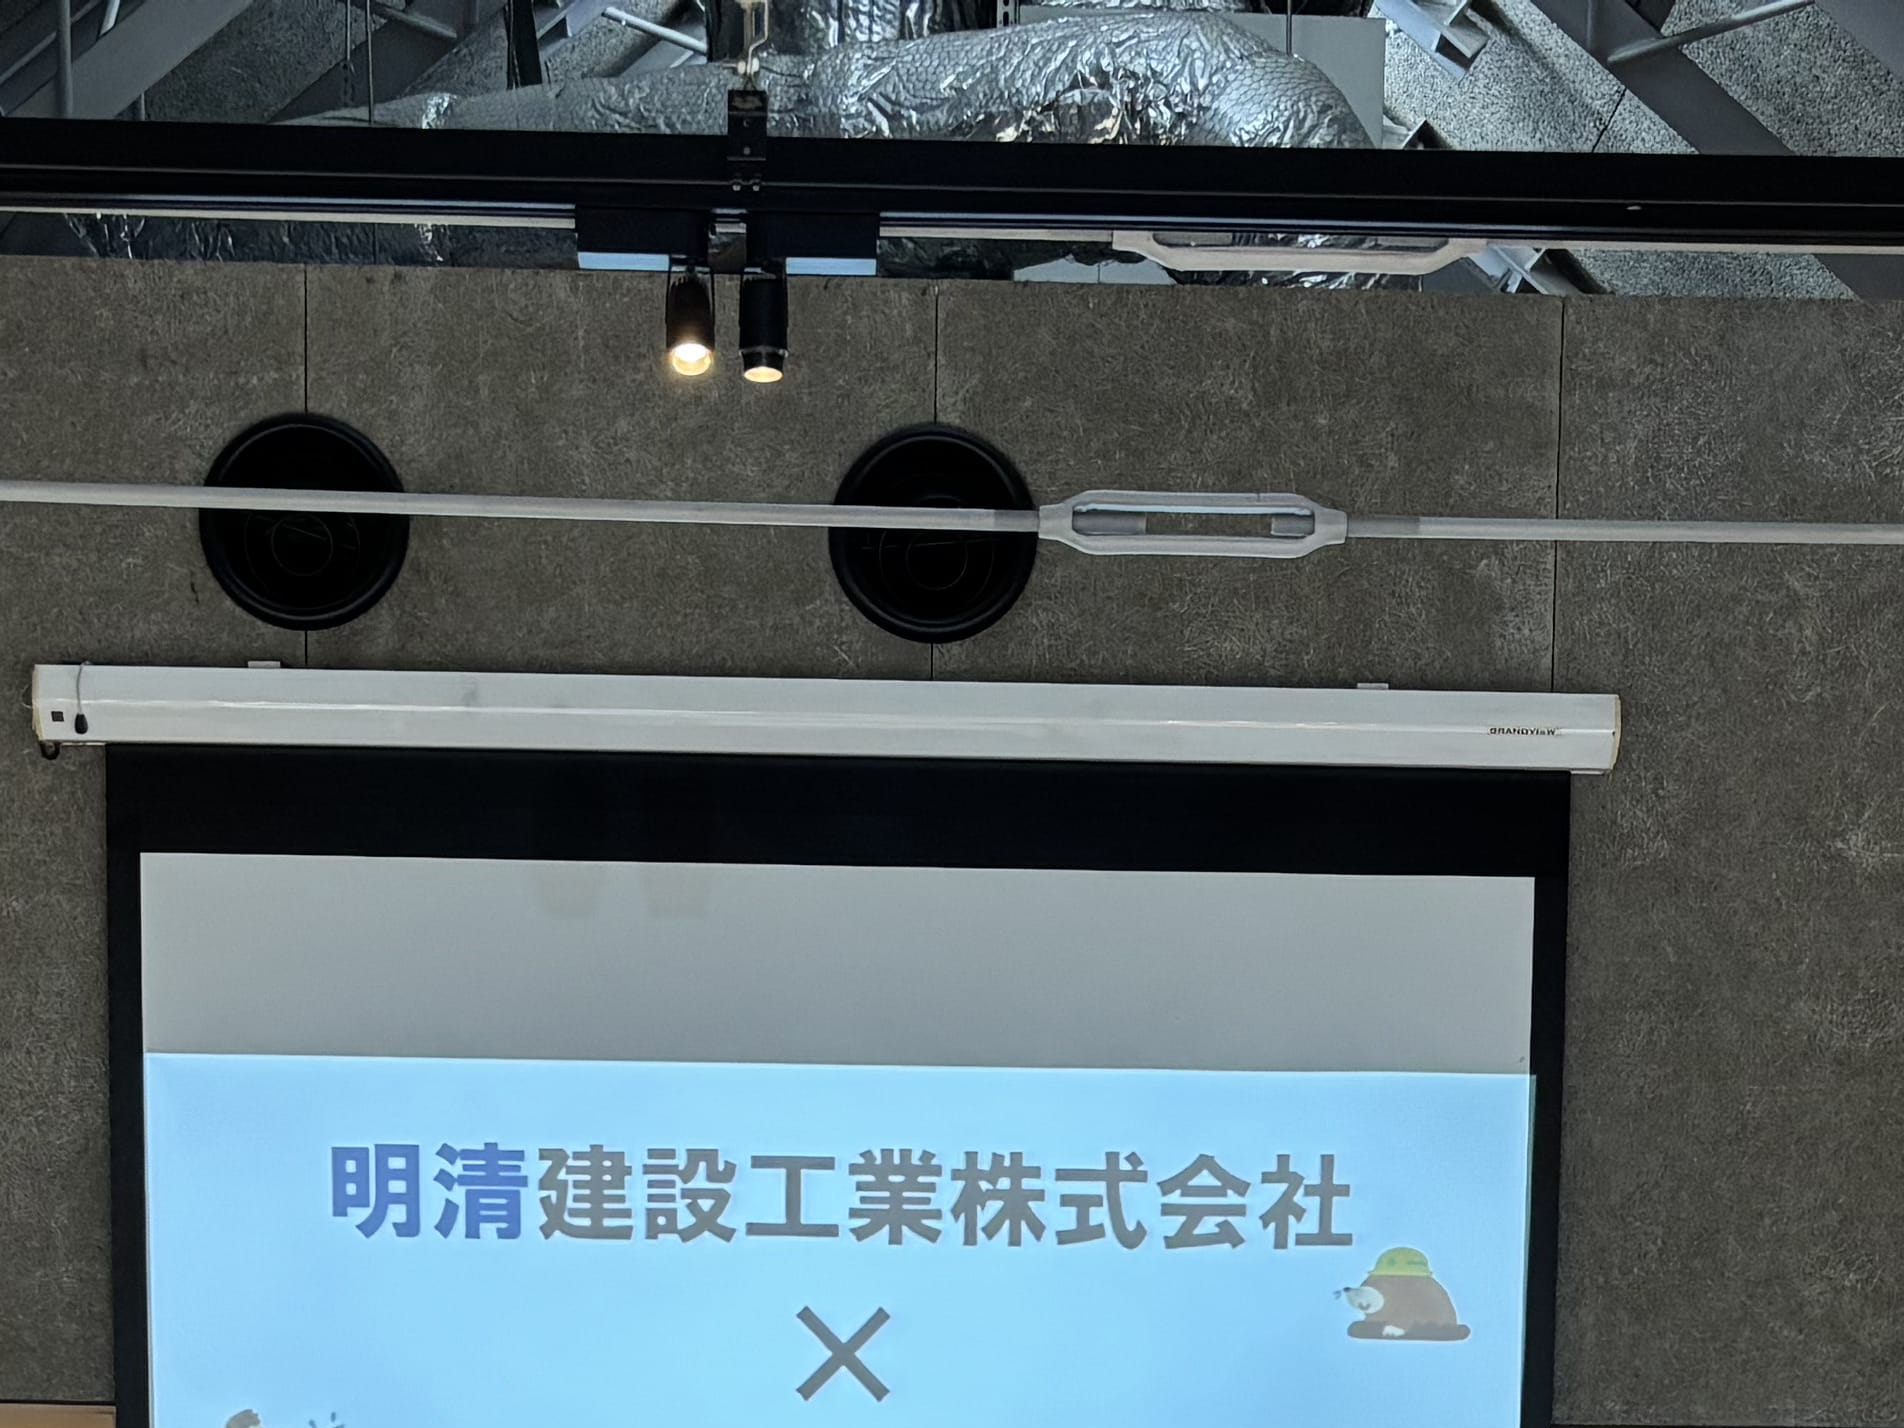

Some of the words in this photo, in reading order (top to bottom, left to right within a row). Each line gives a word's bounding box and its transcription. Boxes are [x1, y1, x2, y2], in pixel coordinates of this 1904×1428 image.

[331, 1141, 1354, 1251] 明清建設工業株式会社
